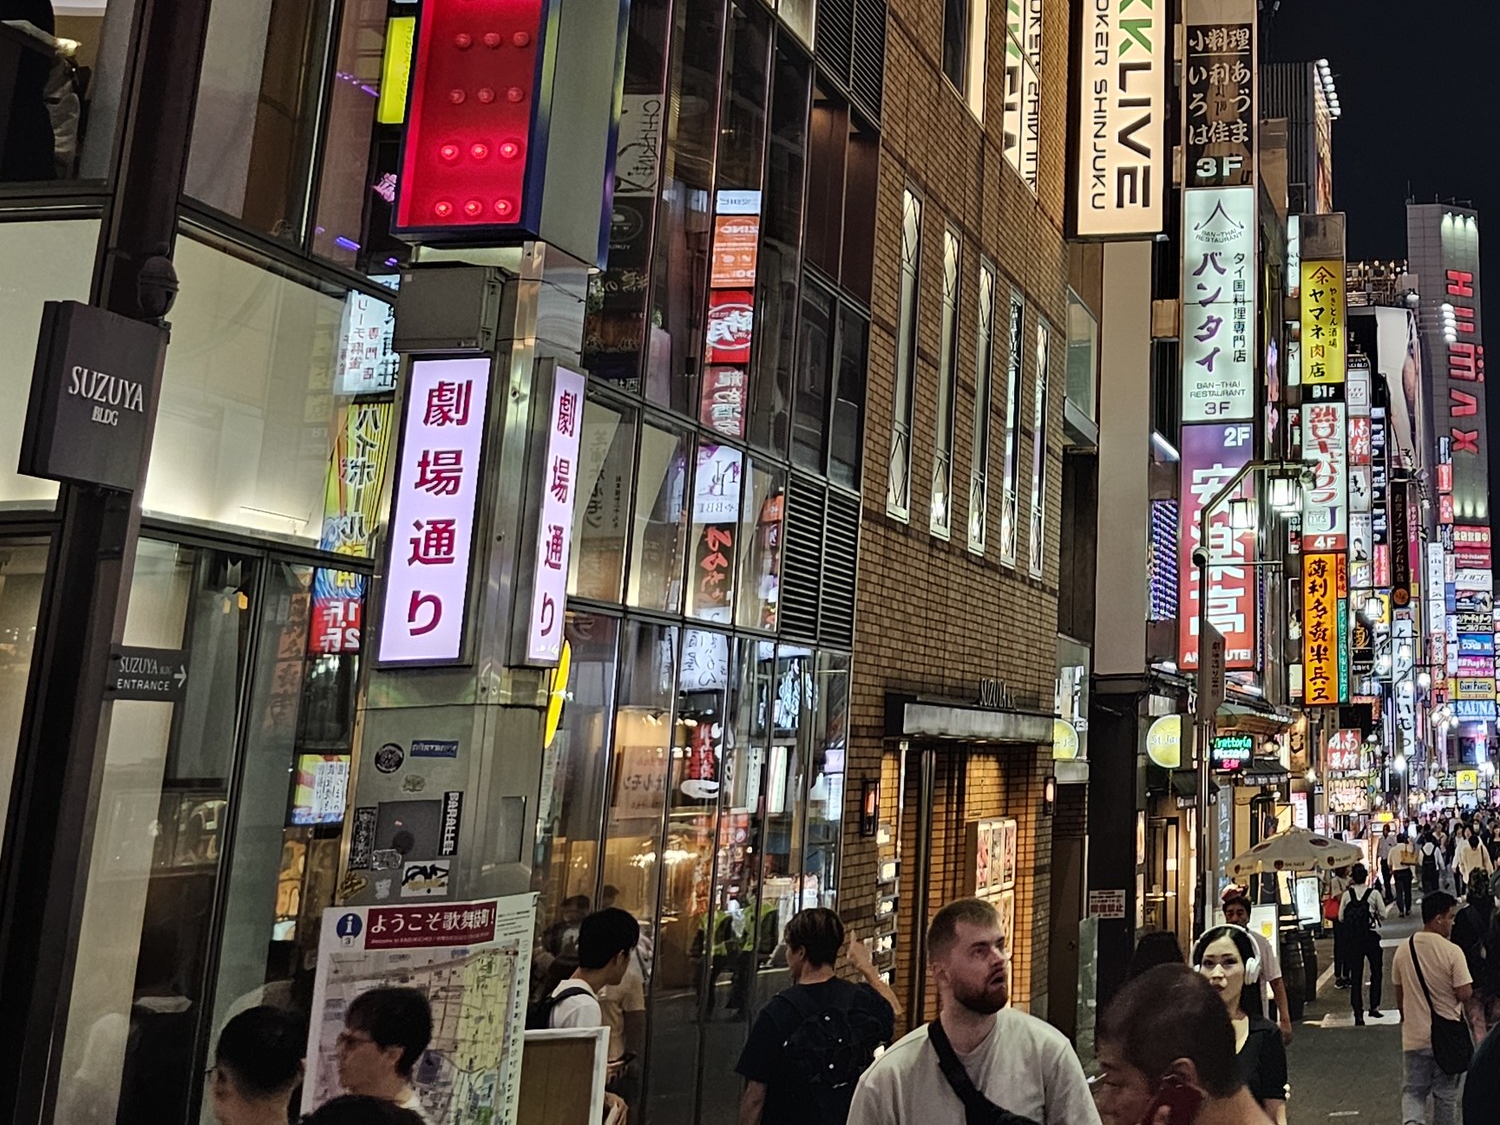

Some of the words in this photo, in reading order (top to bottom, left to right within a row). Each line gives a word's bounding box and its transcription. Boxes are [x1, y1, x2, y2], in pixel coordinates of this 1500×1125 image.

[1189, 28, 1250, 52] 小料理
[1092, 79, 1108, 210] SHINJUKU
[1196, 157, 1243, 177] 3F
[1192, 251, 1227, 373] バンタイ
[1232, 251, 1247, 364] タイ国料理専門店
[68, 366, 144, 413] SUZUYA
[1189, 388, 1247, 399] RESTAURANT
[1196, 380, 1242, 390] BAN-THAI
[91, 406, 119, 427] BLDG
[1204, 402, 1232, 416] 3F
[1224, 428, 1250, 446] 2F
[407, 380, 474, 637] 劇場通り
[541, 389, 578, 637] 劇場通り
[1314, 535, 1336, 549] 4F
[119, 656, 158, 676] SUZUYA
[1183, 649, 1253, 663] ANUTEI
[117, 678, 170, 692] ENTRANCE
[1457, 700, 1496, 716] SAUNA
[371, 908, 496, 934] ようこそ歌舞伎町!
